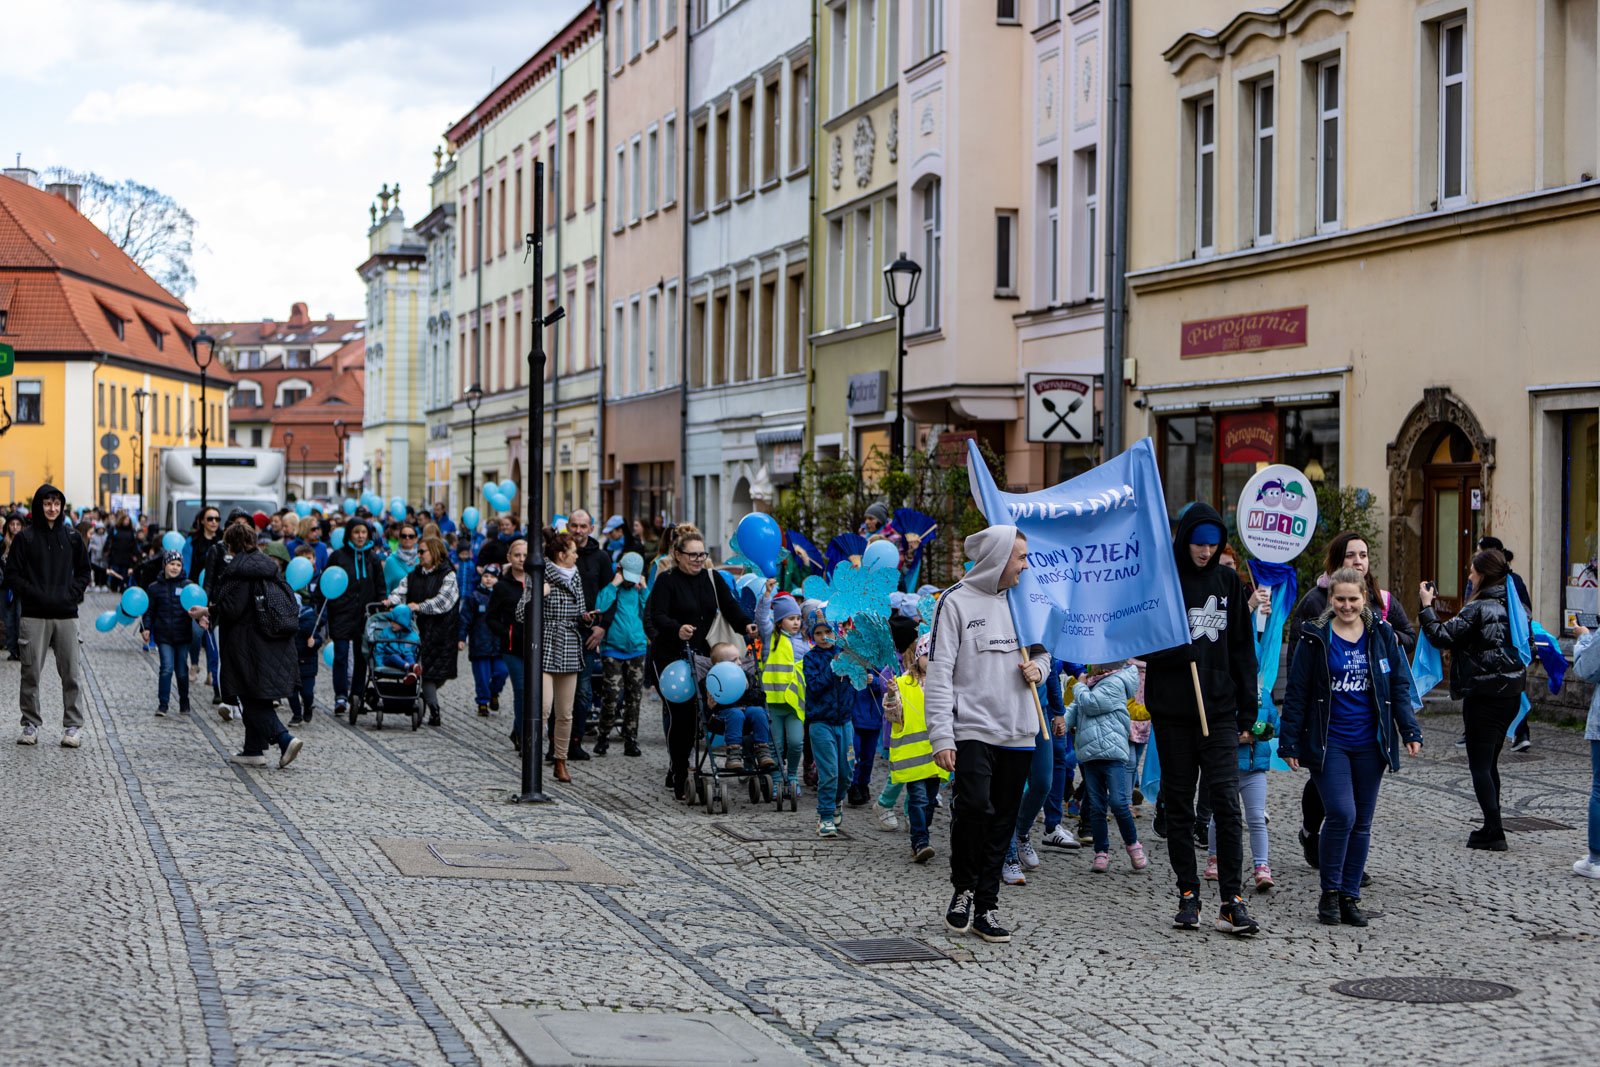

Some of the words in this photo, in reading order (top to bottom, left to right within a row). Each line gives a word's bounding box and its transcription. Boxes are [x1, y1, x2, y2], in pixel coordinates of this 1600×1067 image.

[1187, 313, 1299, 346] Pierogarnia
[1225, 427, 1274, 448] Pierogarnia
[1249, 512, 1304, 534] MP10
[1071, 532, 1140, 564] DZIEŃ
[1068, 625, 1095, 637] GÓRZE
